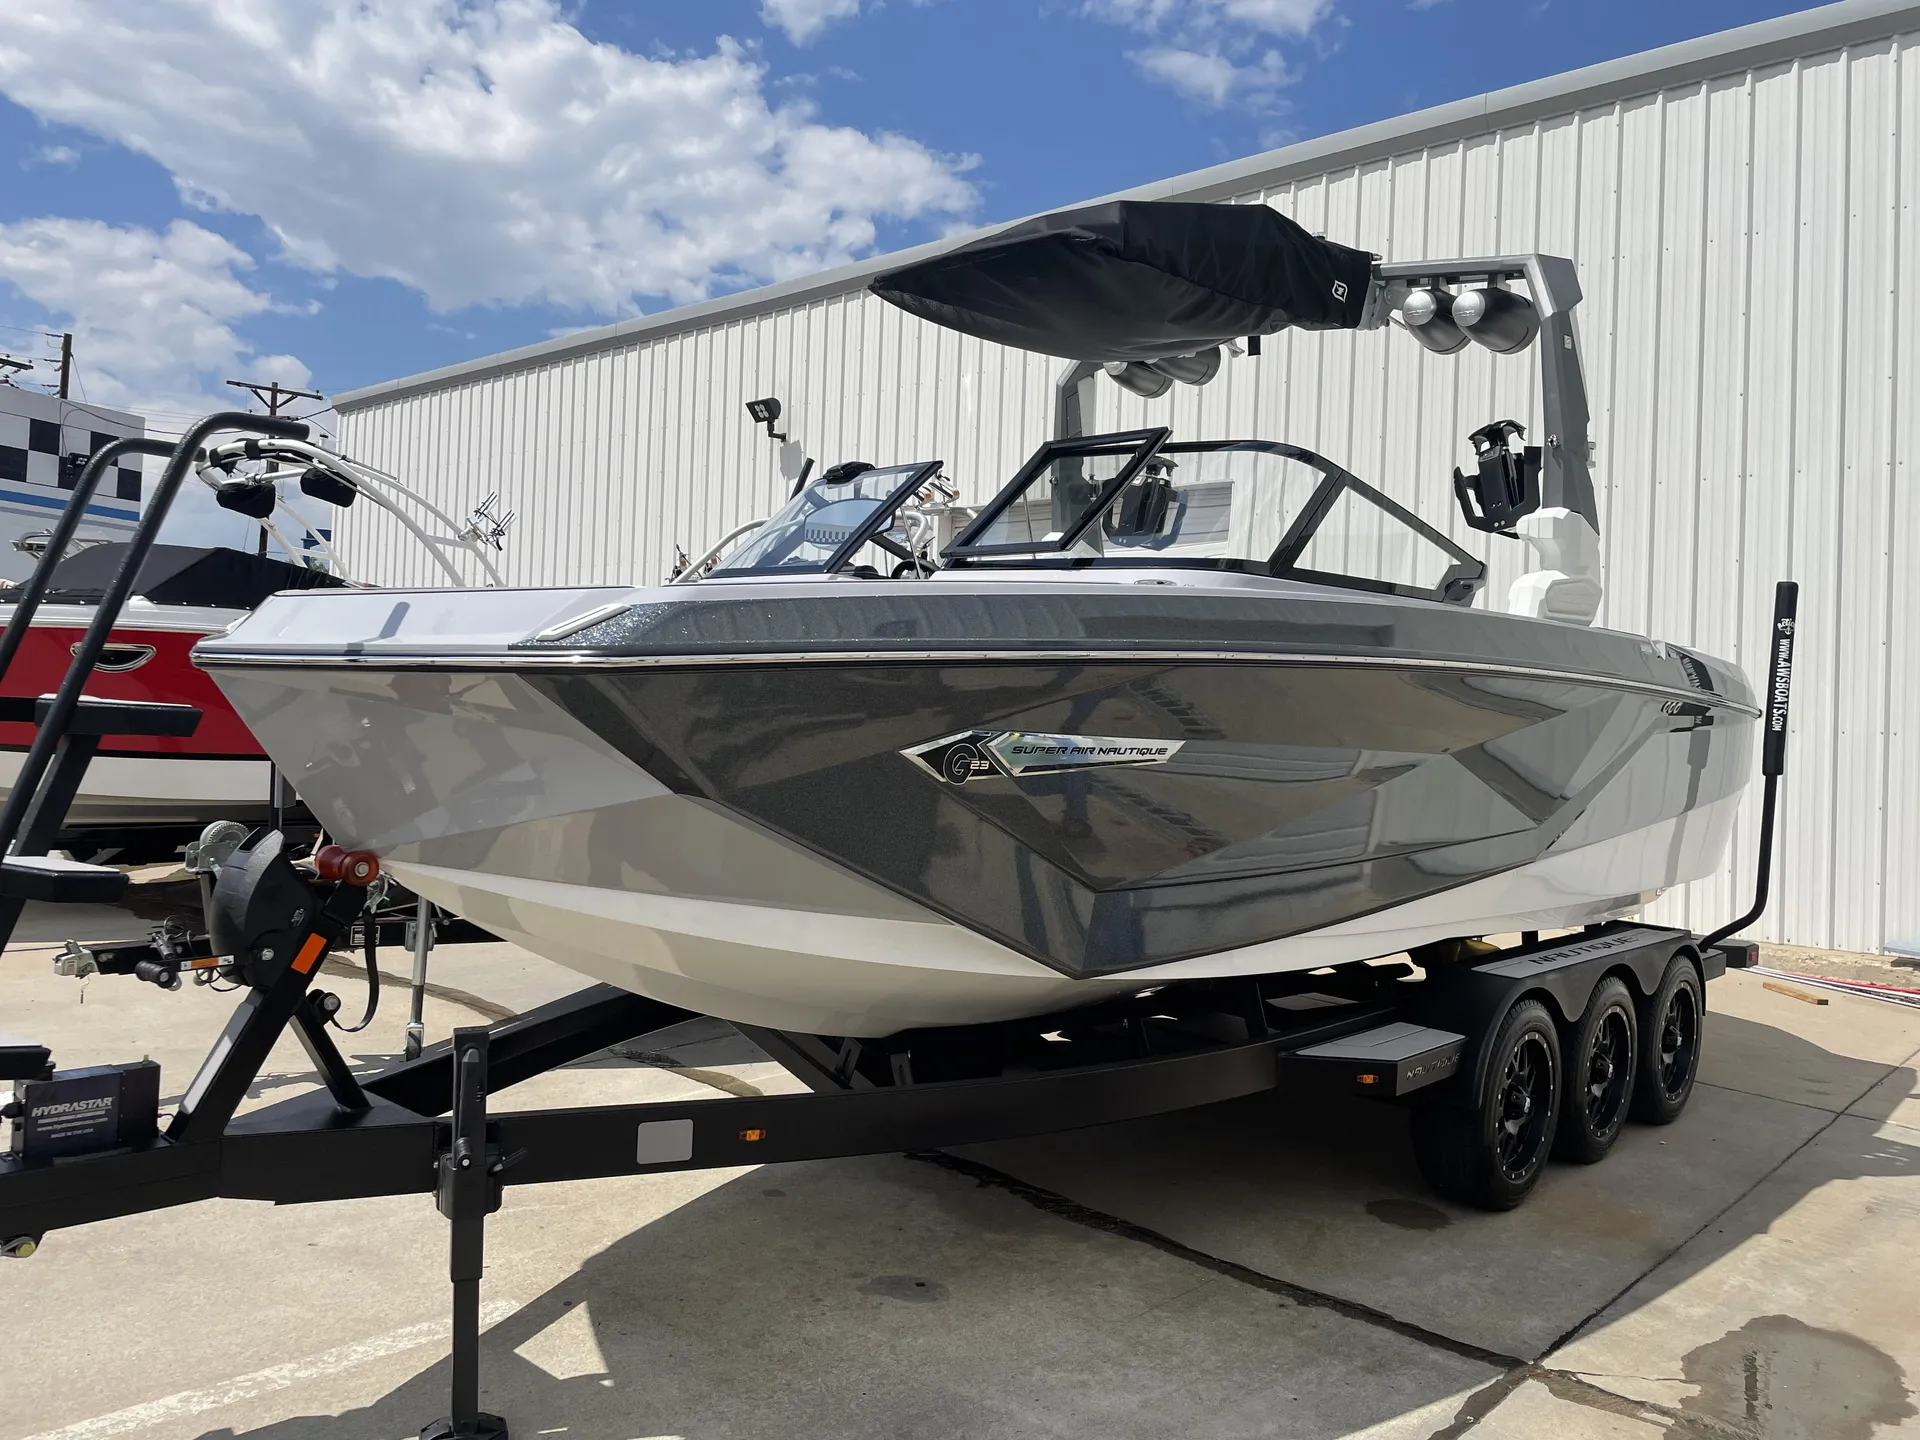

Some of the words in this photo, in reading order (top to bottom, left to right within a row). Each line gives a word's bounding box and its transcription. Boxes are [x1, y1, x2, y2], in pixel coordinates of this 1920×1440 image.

[1771, 638, 1791, 731] WWW.AWSBOATS.COM
[1011, 746, 1068, 756] SUPER
[1068, 746, 1099, 756] AIR
[1099, 746, 1169, 757] NAUTIQUE
[1528, 936, 1640, 965] NAUTIQUE
[1407, 1053, 1460, 1078] NAUTIQUE
[31, 1097, 113, 1117] HYDRASTAR
